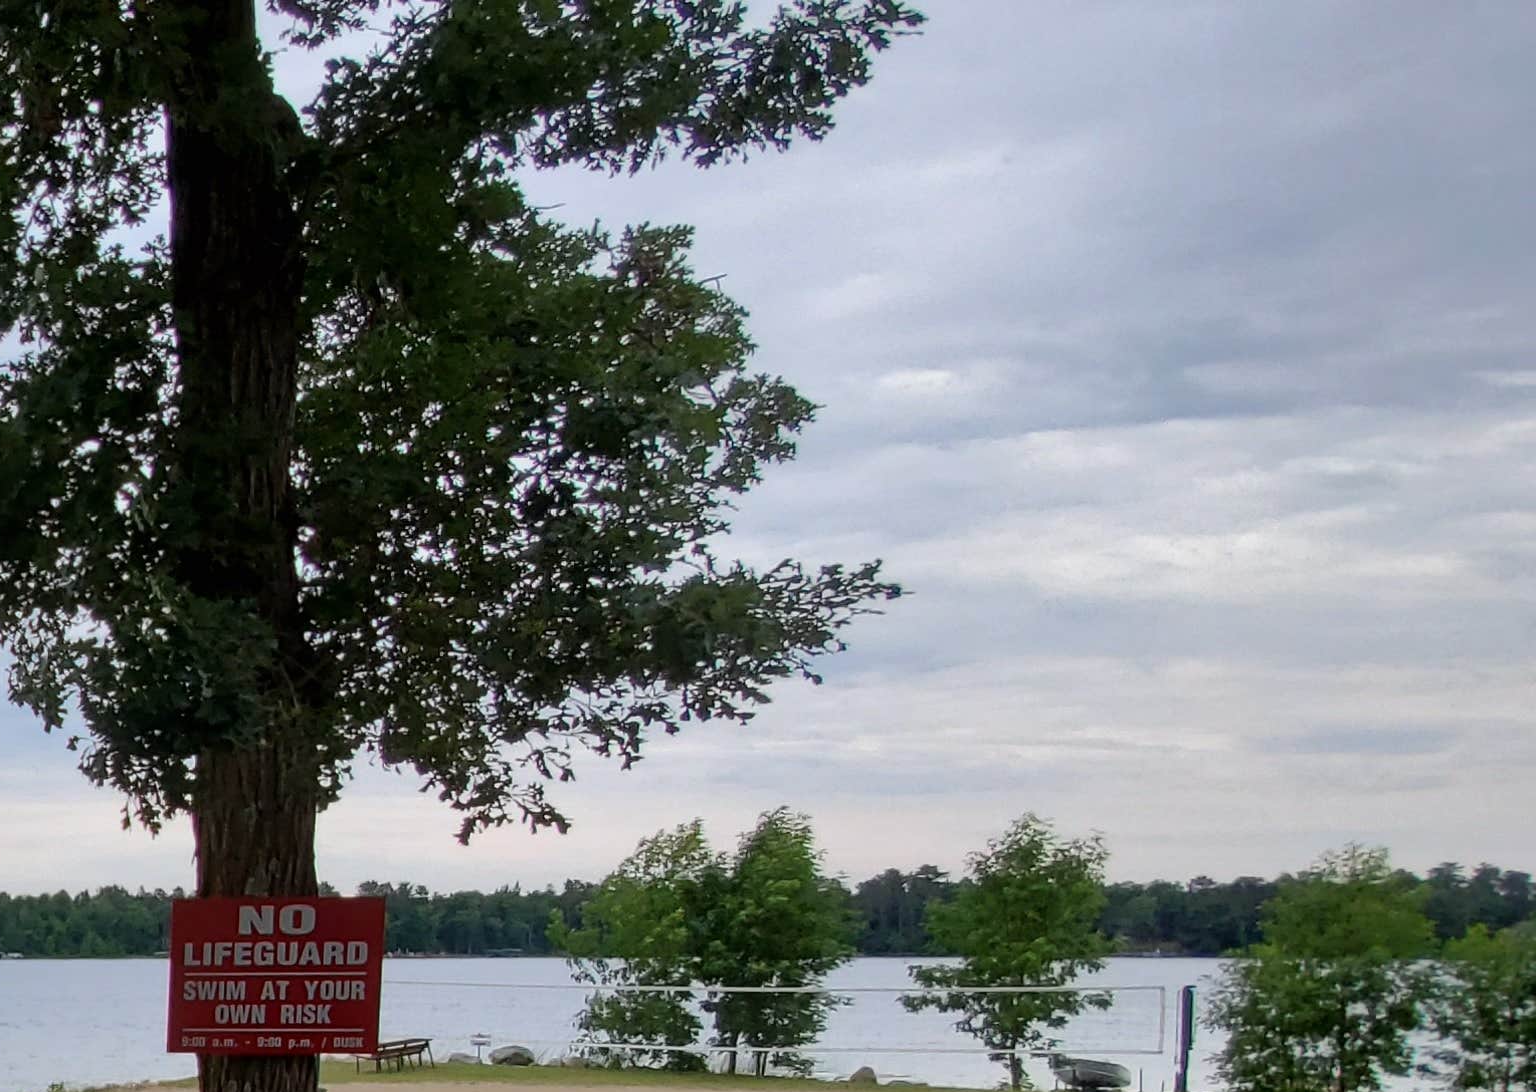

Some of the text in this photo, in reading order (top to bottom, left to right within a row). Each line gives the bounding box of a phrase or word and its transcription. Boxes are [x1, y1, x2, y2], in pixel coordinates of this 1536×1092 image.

[238, 904, 316, 935] NO
[183, 941, 369, 966] LIFEGUARD
[183, 980, 366, 1001] SWIM AT YOUR
[214, 1004, 332, 1024] OWN RISK
[212, 1038, 238, 1047] a.m.
[257, 1037, 282, 1047] 9:00
[288, 1038, 315, 1049] p.m.
[333, 1037, 364, 1048] DUSK
